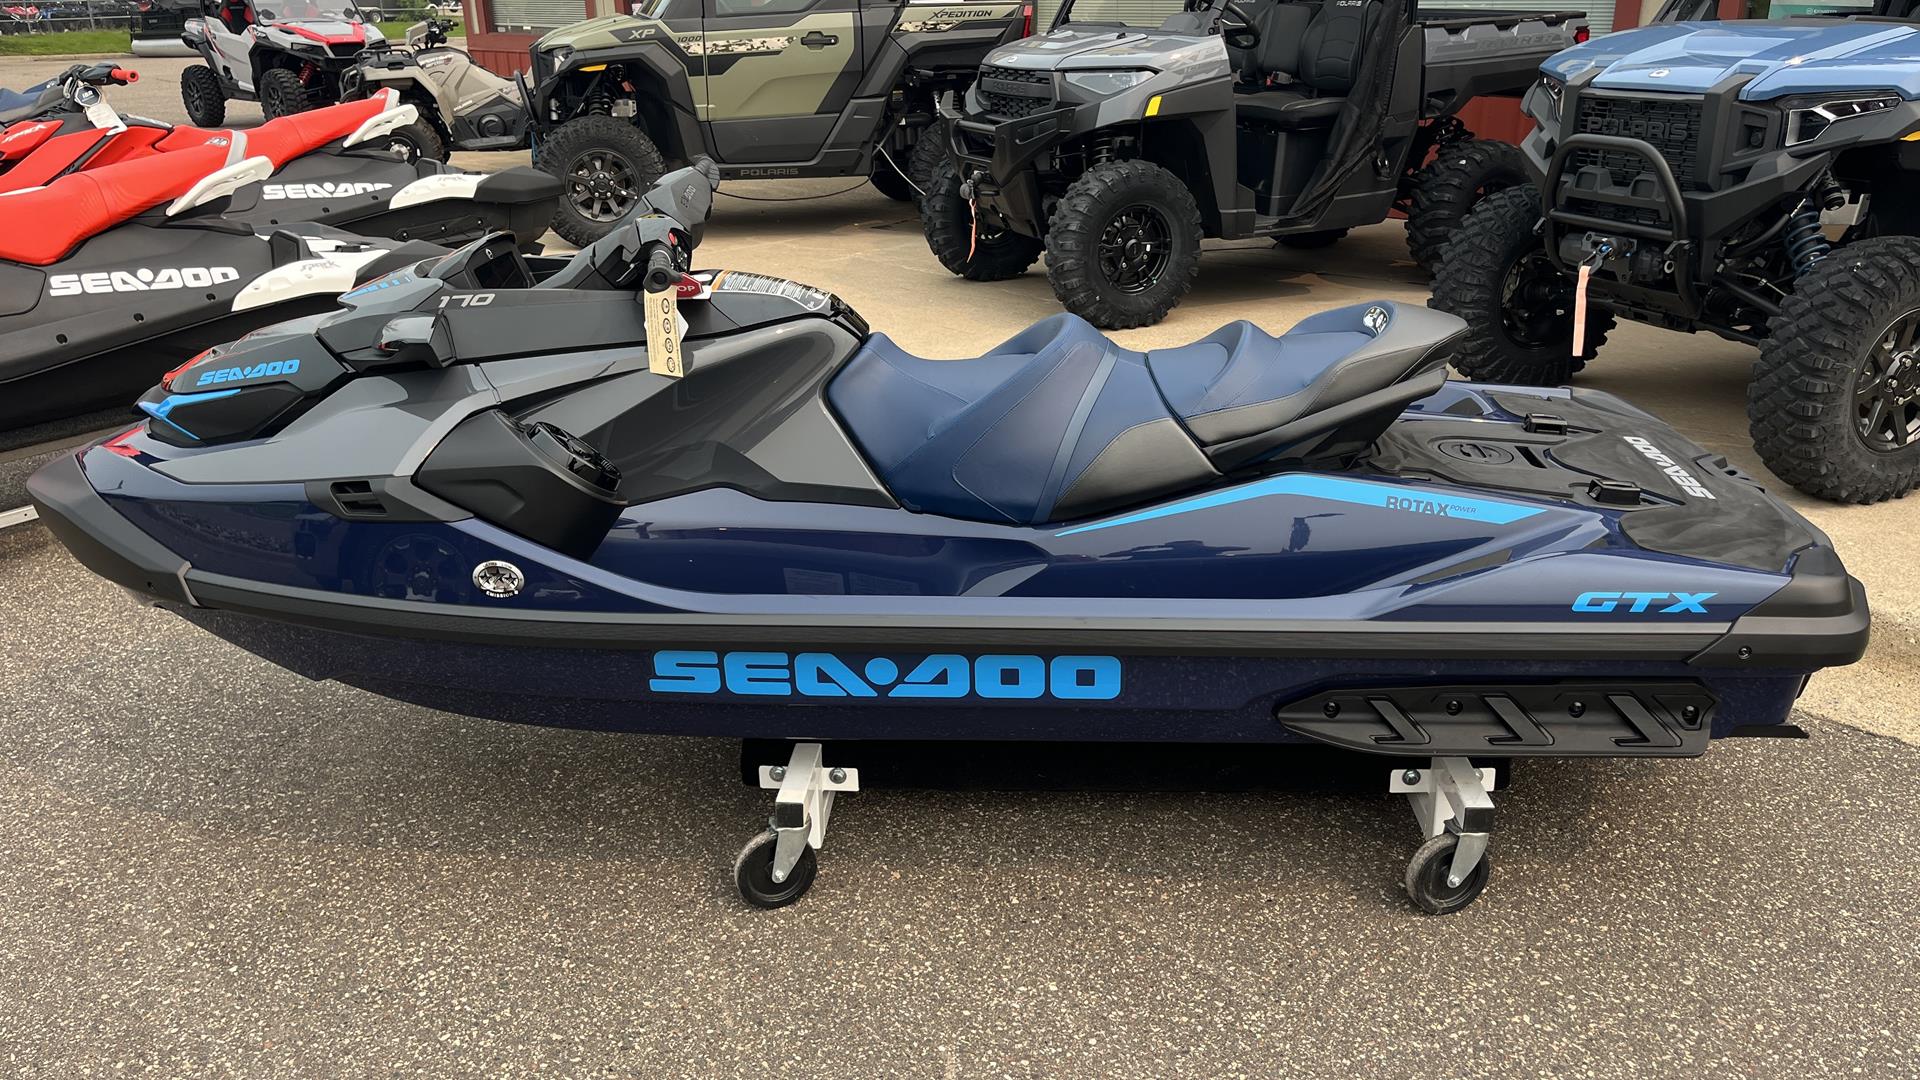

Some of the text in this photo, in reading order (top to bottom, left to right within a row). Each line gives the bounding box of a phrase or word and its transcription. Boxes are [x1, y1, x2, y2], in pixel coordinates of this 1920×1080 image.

[928, 8, 992, 20] XPEDITION
[629, 28, 656, 40] XP
[676, 34, 702, 42] 1000
[1586, 116, 1689, 141] POLARIS
[740, 168, 799, 176] POLARIS
[438, 293, 496, 308] 170
[1385, 495, 1477, 517] ROTAX POWER
[1572, 592, 1718, 613] GTX
